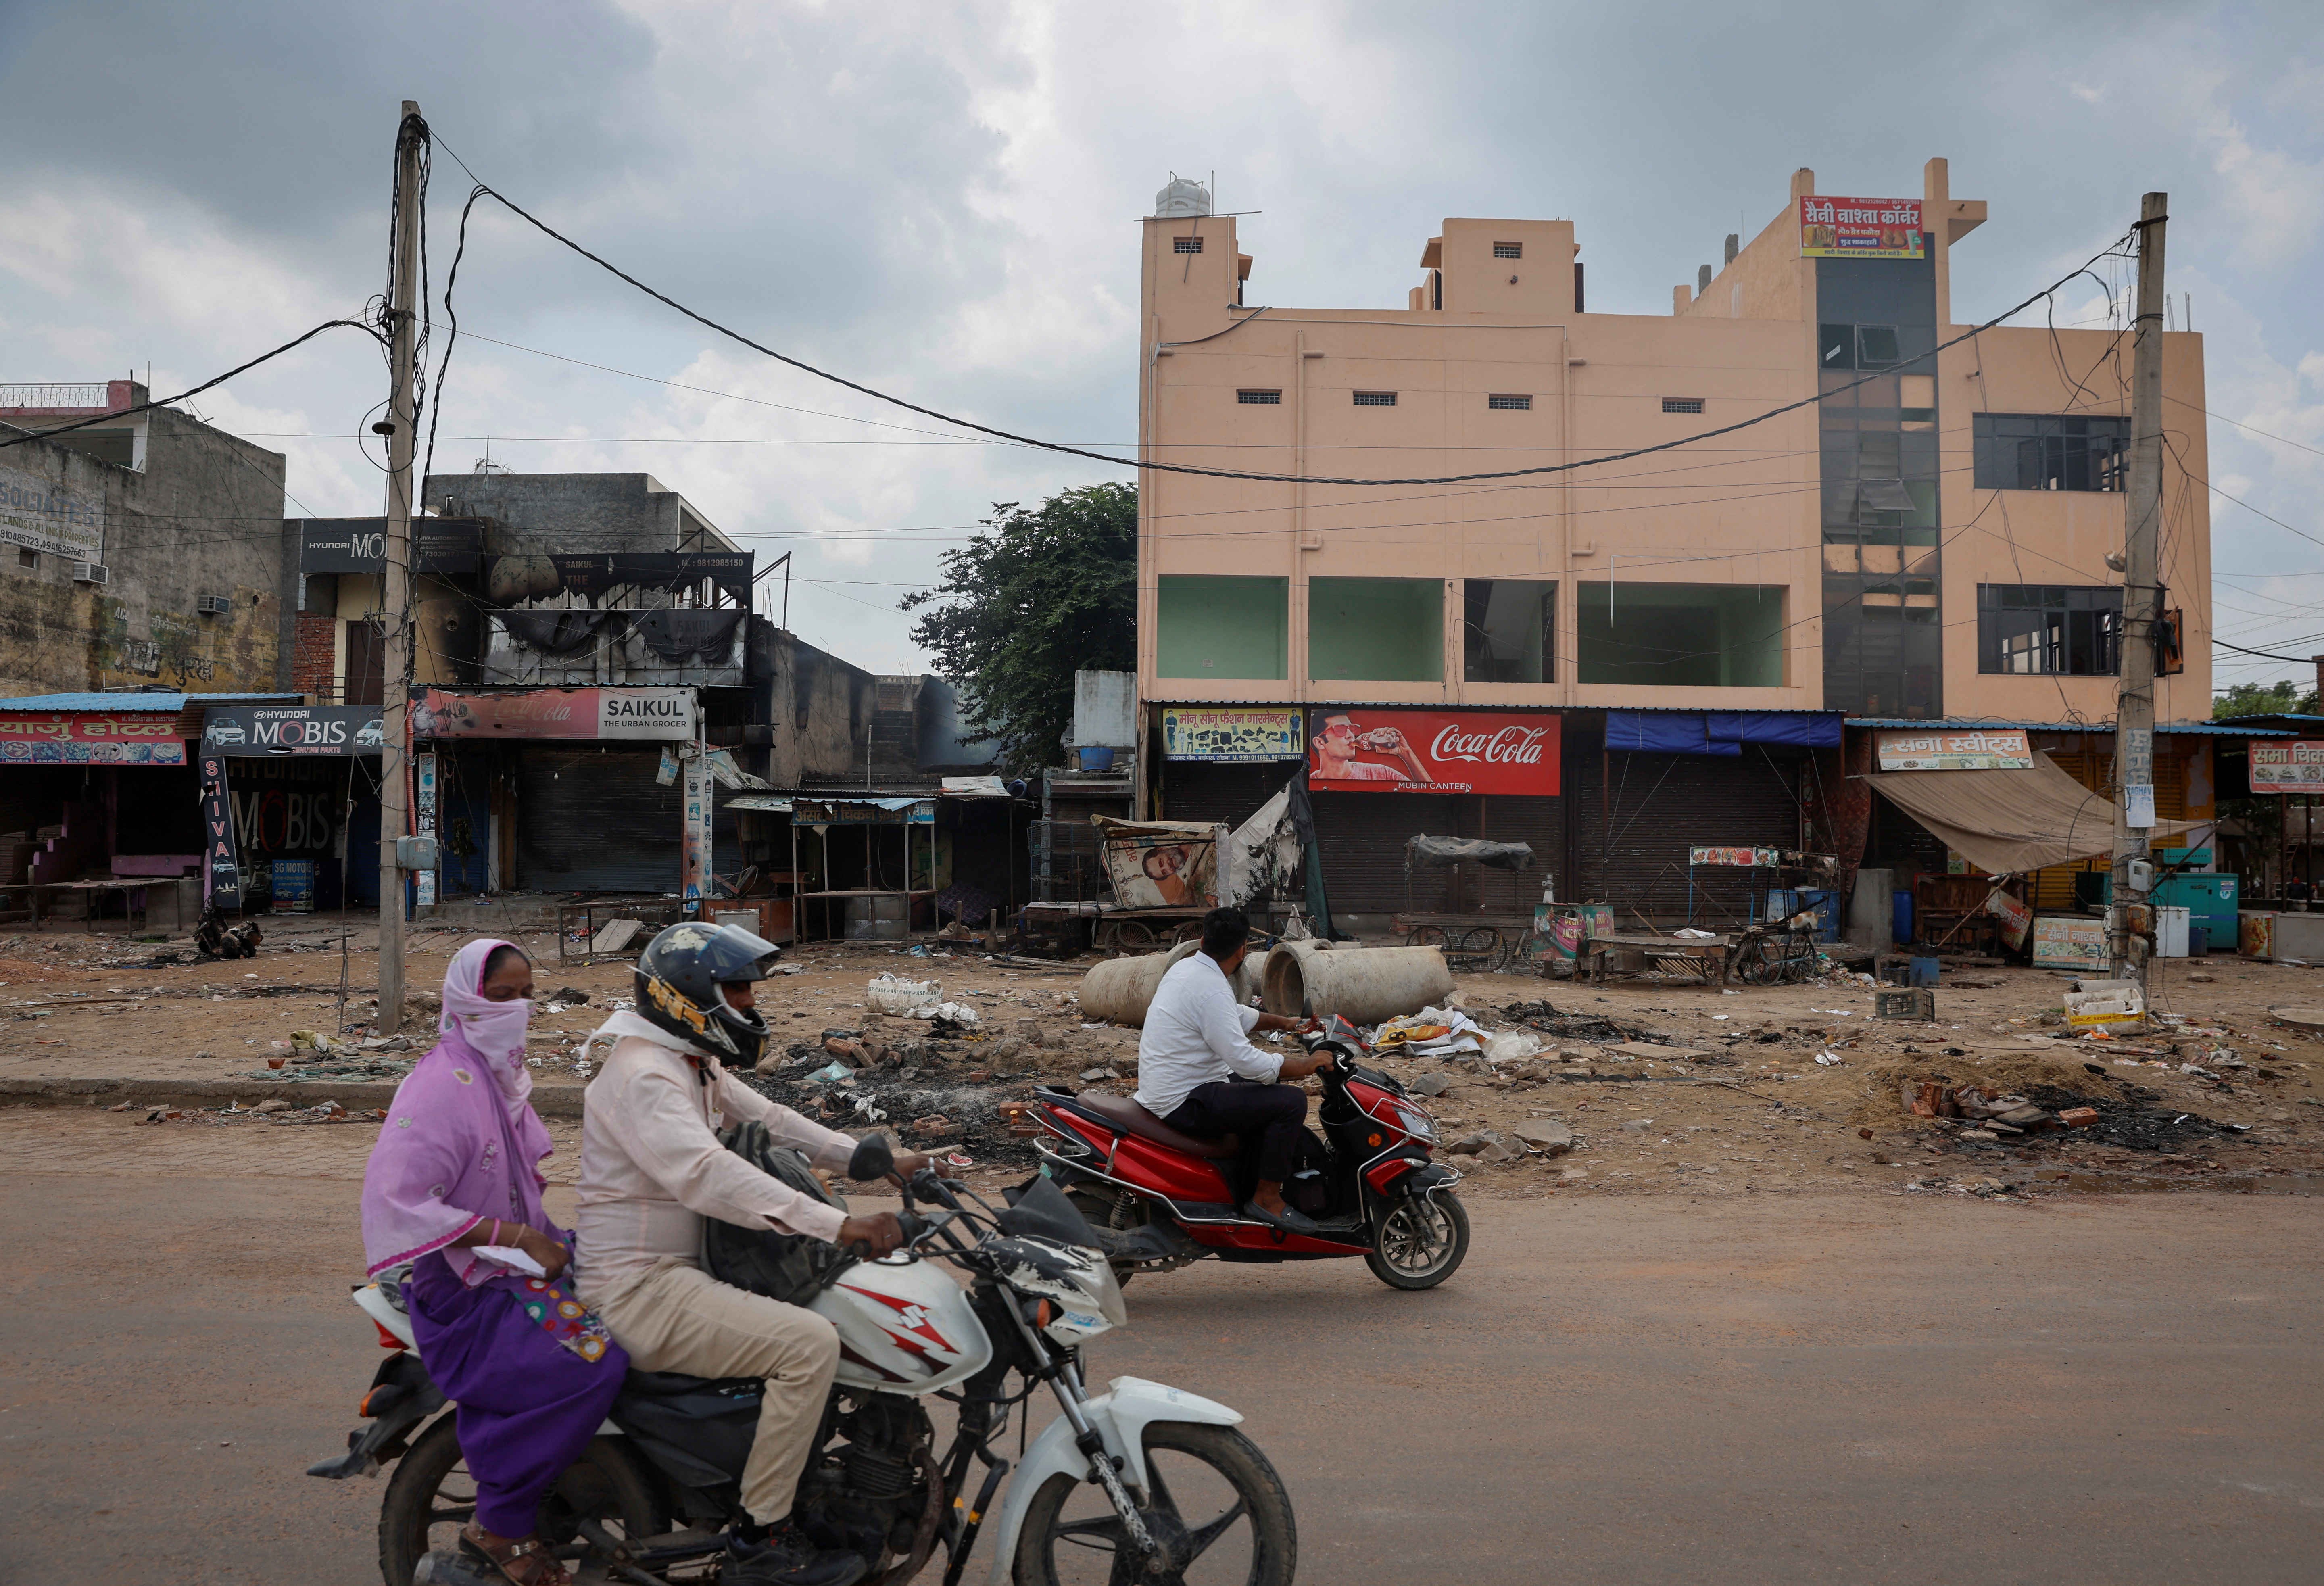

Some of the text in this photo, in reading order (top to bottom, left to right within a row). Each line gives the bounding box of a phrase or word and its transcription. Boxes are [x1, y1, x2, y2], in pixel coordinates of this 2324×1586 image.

[1805, 201, 1919, 225] सैनी नाश्ता कॉर्नर
[29, 522, 35, 530] &
[35, 523, 45, 534] ALL
[65, 530, 99, 548] PROPERTIES
[565, 561, 593, 569] SAIKUL
[697, 558, 743, 567] 9812985150
[565, 574, 588, 586] THE
[267, 710, 310, 719] HYUNDAI
[607, 700, 684, 716] SAIKUL
[1179, 709, 1288, 729] मोनू सोनू फैशन गारमेन्ट्स
[252, 720, 346, 745] MOBIS
[1430, 724, 1550, 764] Coca-Cola
[1429, 782, 1473, 791] CANTEEN
[2127, 786, 2152, 795] RAGHAV
[229, 789, 330, 852] MOBIS
[841, 804, 876, 822] चिकन
[274, 862, 312, 873] SG MOTORS
[2048, 925, 2069, 941] सैनी
[2071, 930, 2102, 942] नाश्ता
